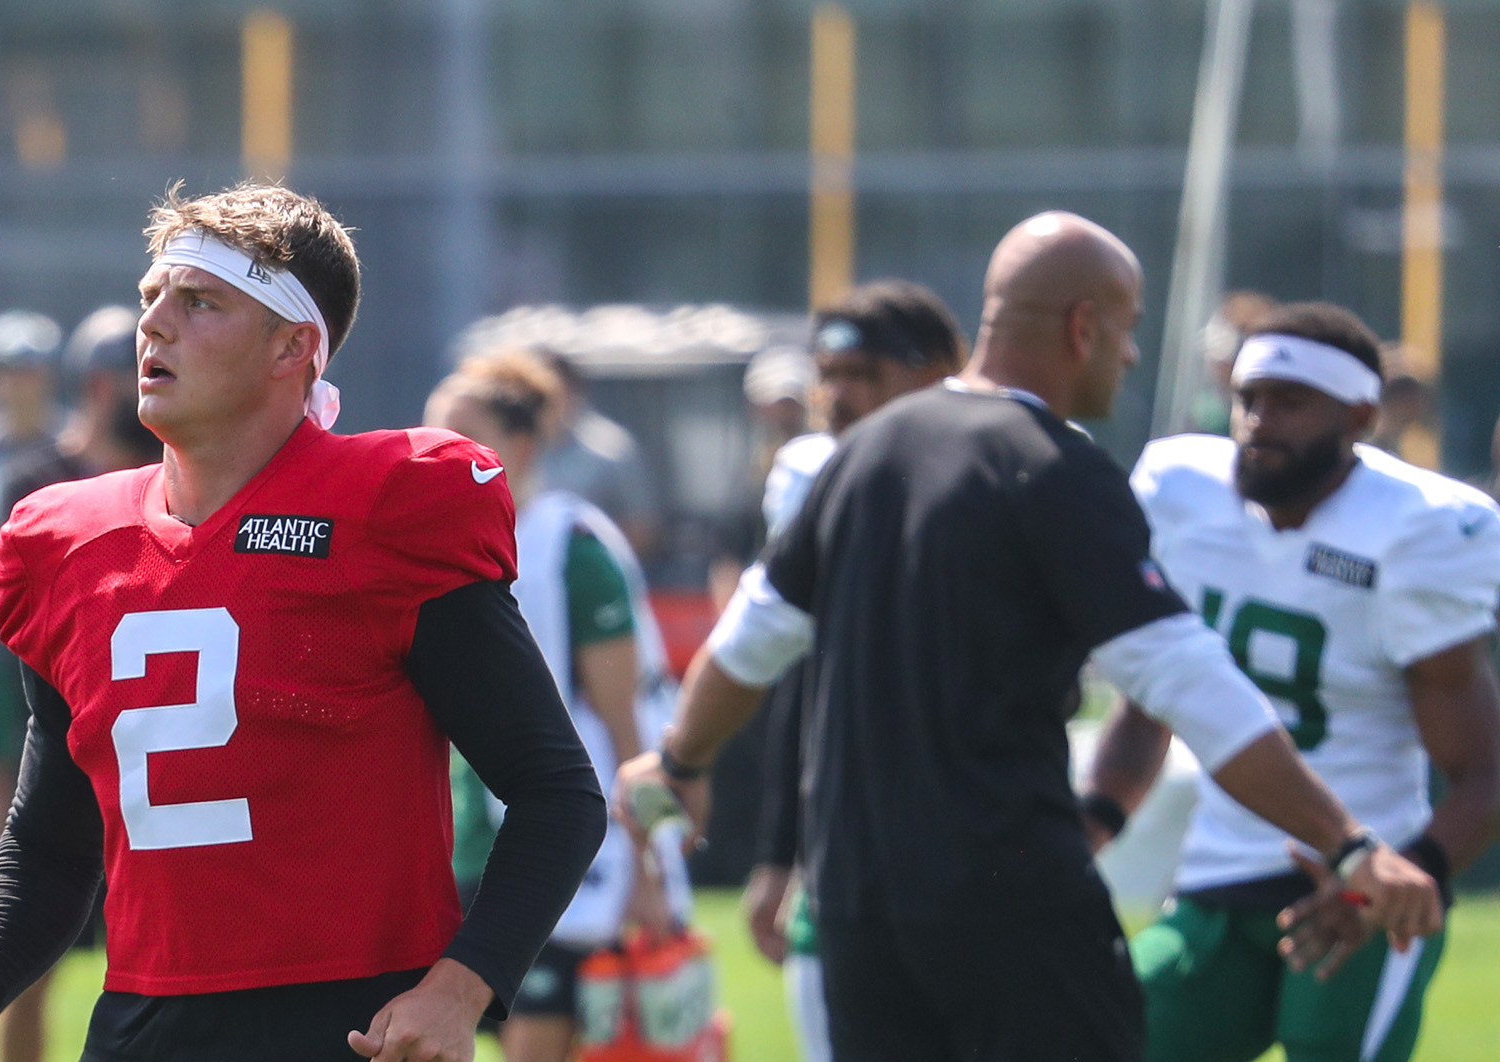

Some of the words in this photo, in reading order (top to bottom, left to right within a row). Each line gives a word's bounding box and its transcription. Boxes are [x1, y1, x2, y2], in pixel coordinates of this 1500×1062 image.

[238, 518, 330, 539] ATLANTIC
[246, 533, 316, 554] HEALTH
[110, 606, 254, 851] 2
